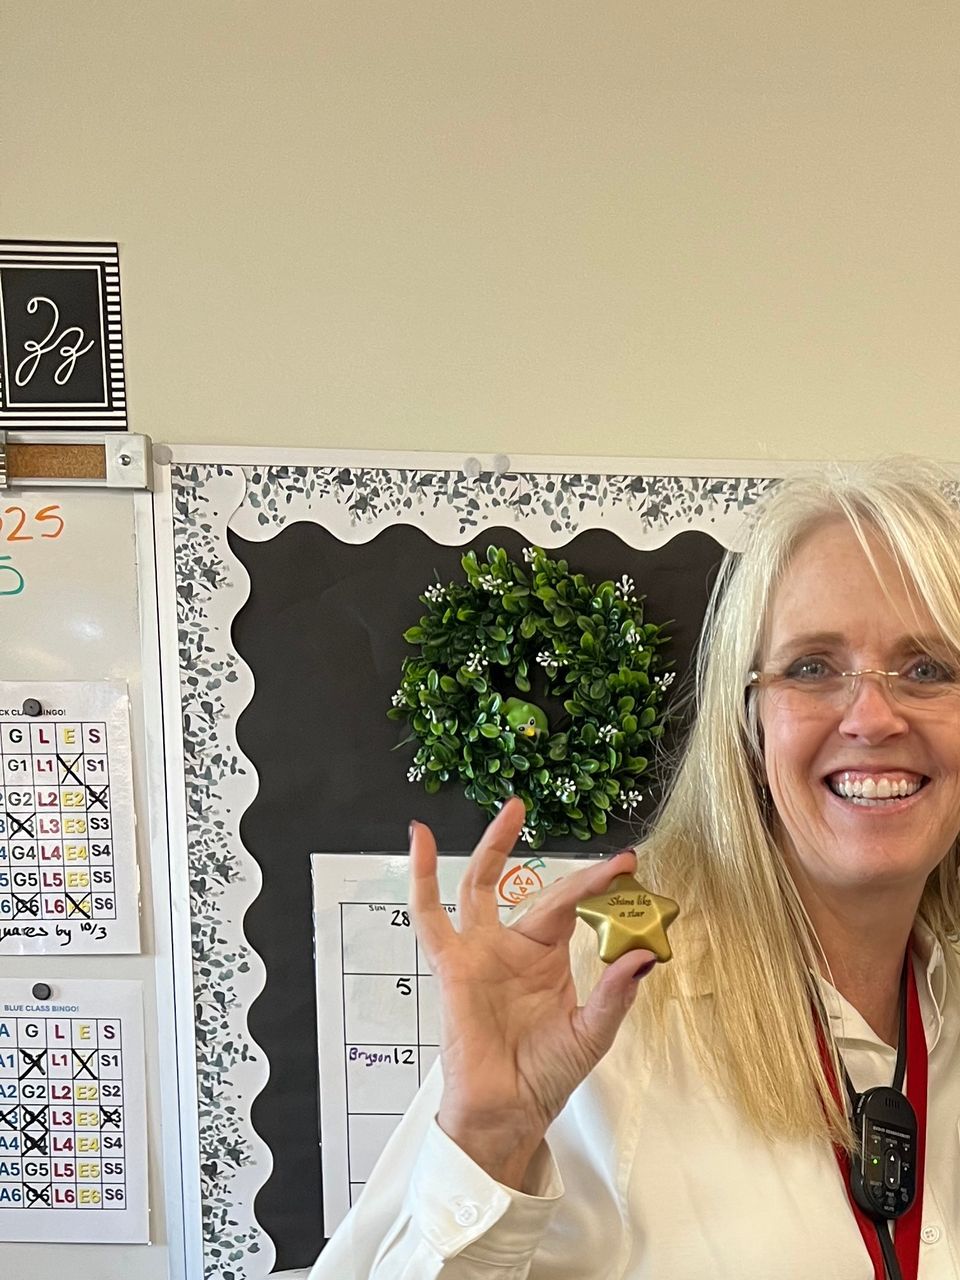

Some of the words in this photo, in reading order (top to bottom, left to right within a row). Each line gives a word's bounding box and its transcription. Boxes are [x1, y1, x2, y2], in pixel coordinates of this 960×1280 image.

[12, 846, 36, 860] G4
[41, 846, 61, 860] L4
[66, 845, 88, 860] E4
[92, 845, 111, 856] S4
[391, 910, 411, 927] 28
[56, 924, 71, 945] by
[81, 922, 107, 940] 10/3
[396, 977, 412, 995] 5
[4, 1004, 23, 1012] BLUE
[25, 1024, 38, 1038] G
[54, 1024, 65, 1039] L
[79, 1024, 91, 1040] E
[103, 1025, 115, 1039] S
[394, 1047, 415, 1064] 12
[22, 1085, 46, 1098] G2
[51, 1085, 72, 1099] L2
[76, 1085, 98, 1100] E2
[102, 1085, 121, 1097] S2
